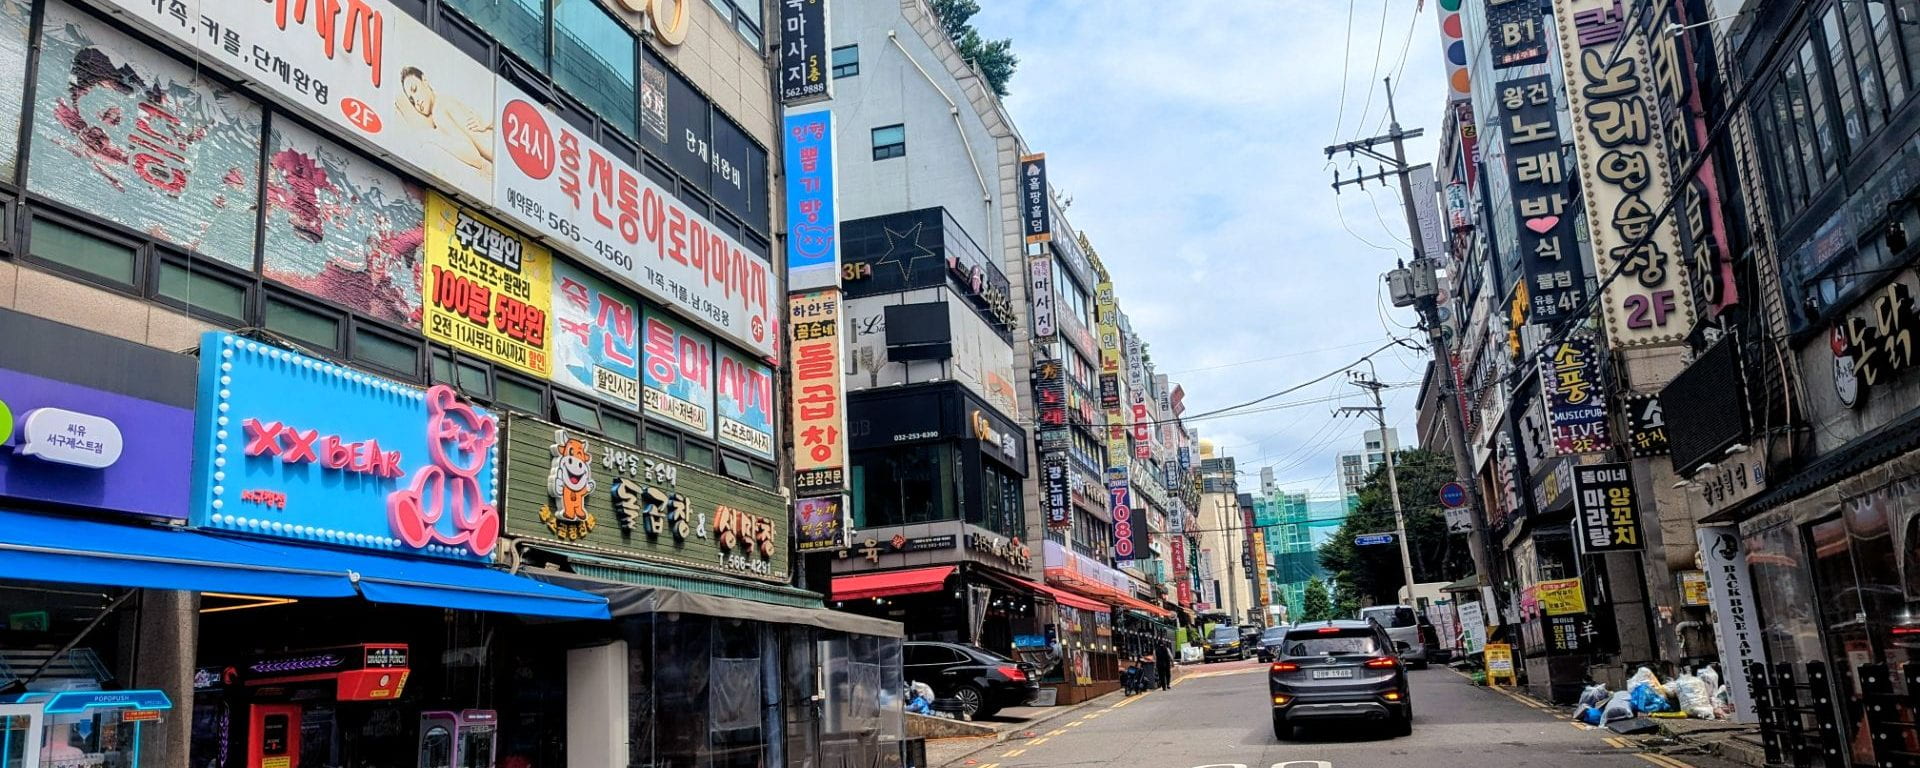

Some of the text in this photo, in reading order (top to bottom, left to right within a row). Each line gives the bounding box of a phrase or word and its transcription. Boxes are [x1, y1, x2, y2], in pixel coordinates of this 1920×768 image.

[1503, 18, 1535, 47] B1
[785, 83, 824, 98] 562.9888
[1502, 81, 1550, 110] 왕건
[350, 101, 376, 128] 2F
[507, 113, 549, 170] 24시
[792, 122, 825, 142] 인형
[559, 127, 581, 209] 중국
[799, 146, 822, 223] 뽑기방
[457, 212, 522, 270] 주간할인
[506, 186, 633, 272] 예약문의: 565-4560
[588, 148, 768, 322] 전통아로마마사지
[448, 246, 531, 300] 전신스포츠+발관리
[843, 261, 869, 281] 3F
[1536, 269, 1572, 291] 클럽
[432, 265, 546, 349] 100분 5만원
[793, 301, 835, 318] 하안동
[1035, 277, 1052, 327] 마사지
[1557, 289, 1581, 312] 4F
[1623, 289, 1677, 330] 2F
[751, 318, 764, 341] 2F
[796, 321, 834, 340] 곰순네
[1100, 288, 1117, 350] 선샤인
[432, 313, 546, 371] 오전 11시부터 6시까지 할인
[598, 368, 636, 406] 할인시간
[1553, 342, 1592, 405] 소풍
[797, 342, 838, 463] 돌곱창
[67, 423, 87, 436] 씨유
[721, 419, 770, 450] 스포츠마사지
[1132, 404, 1150, 441] PC
[1557, 420, 1605, 439] LIVE
[1635, 427, 1668, 449] 뮤직
[47, 434, 104, 455] 서구제스트점
[242, 418, 405, 479] XX BEAR
[1571, 438, 1595, 451] 2F
[602, 446, 640, 476] 하안동
[797, 469, 841, 488] 소곱창전문
[1111, 487, 1134, 557] 7080
[1583, 488, 1612, 547] 마라탕
[1608, 486, 1637, 545] 양꼬치
[1723, 565, 1741, 597] BACK
[1730, 598, 1746, 631] BONE
[1580, 619, 1599, 644] 羊
